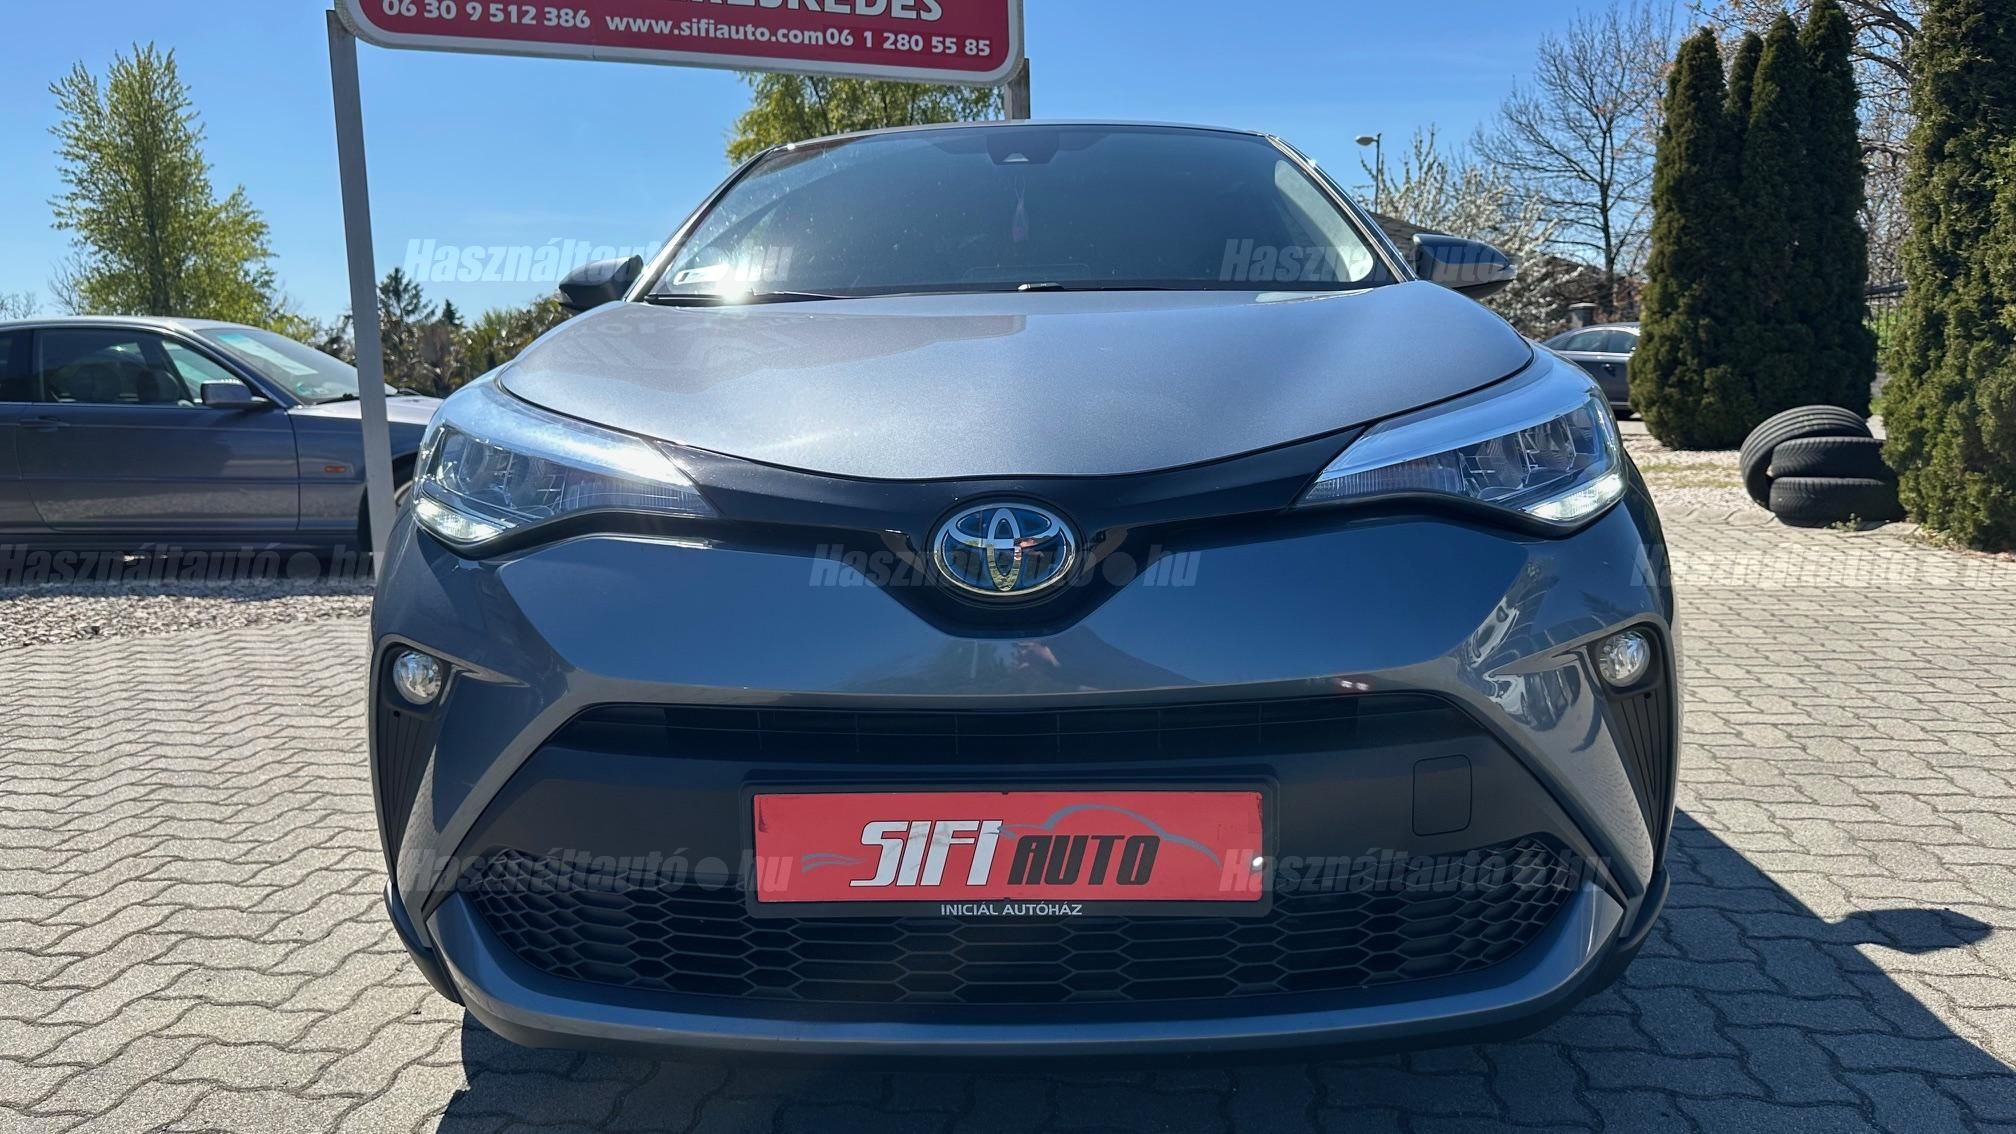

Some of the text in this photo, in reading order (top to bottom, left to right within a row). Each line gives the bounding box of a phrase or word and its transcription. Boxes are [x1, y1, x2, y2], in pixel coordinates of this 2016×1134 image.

[382, 0, 990, 56] 06 30 9 512 386 www.sifiauto.com 06 1 280 55 85
[1006, 834, 1161, 887] AUTO
[940, 900, 1083, 916] INICIÁL AUTÓHÁZ
